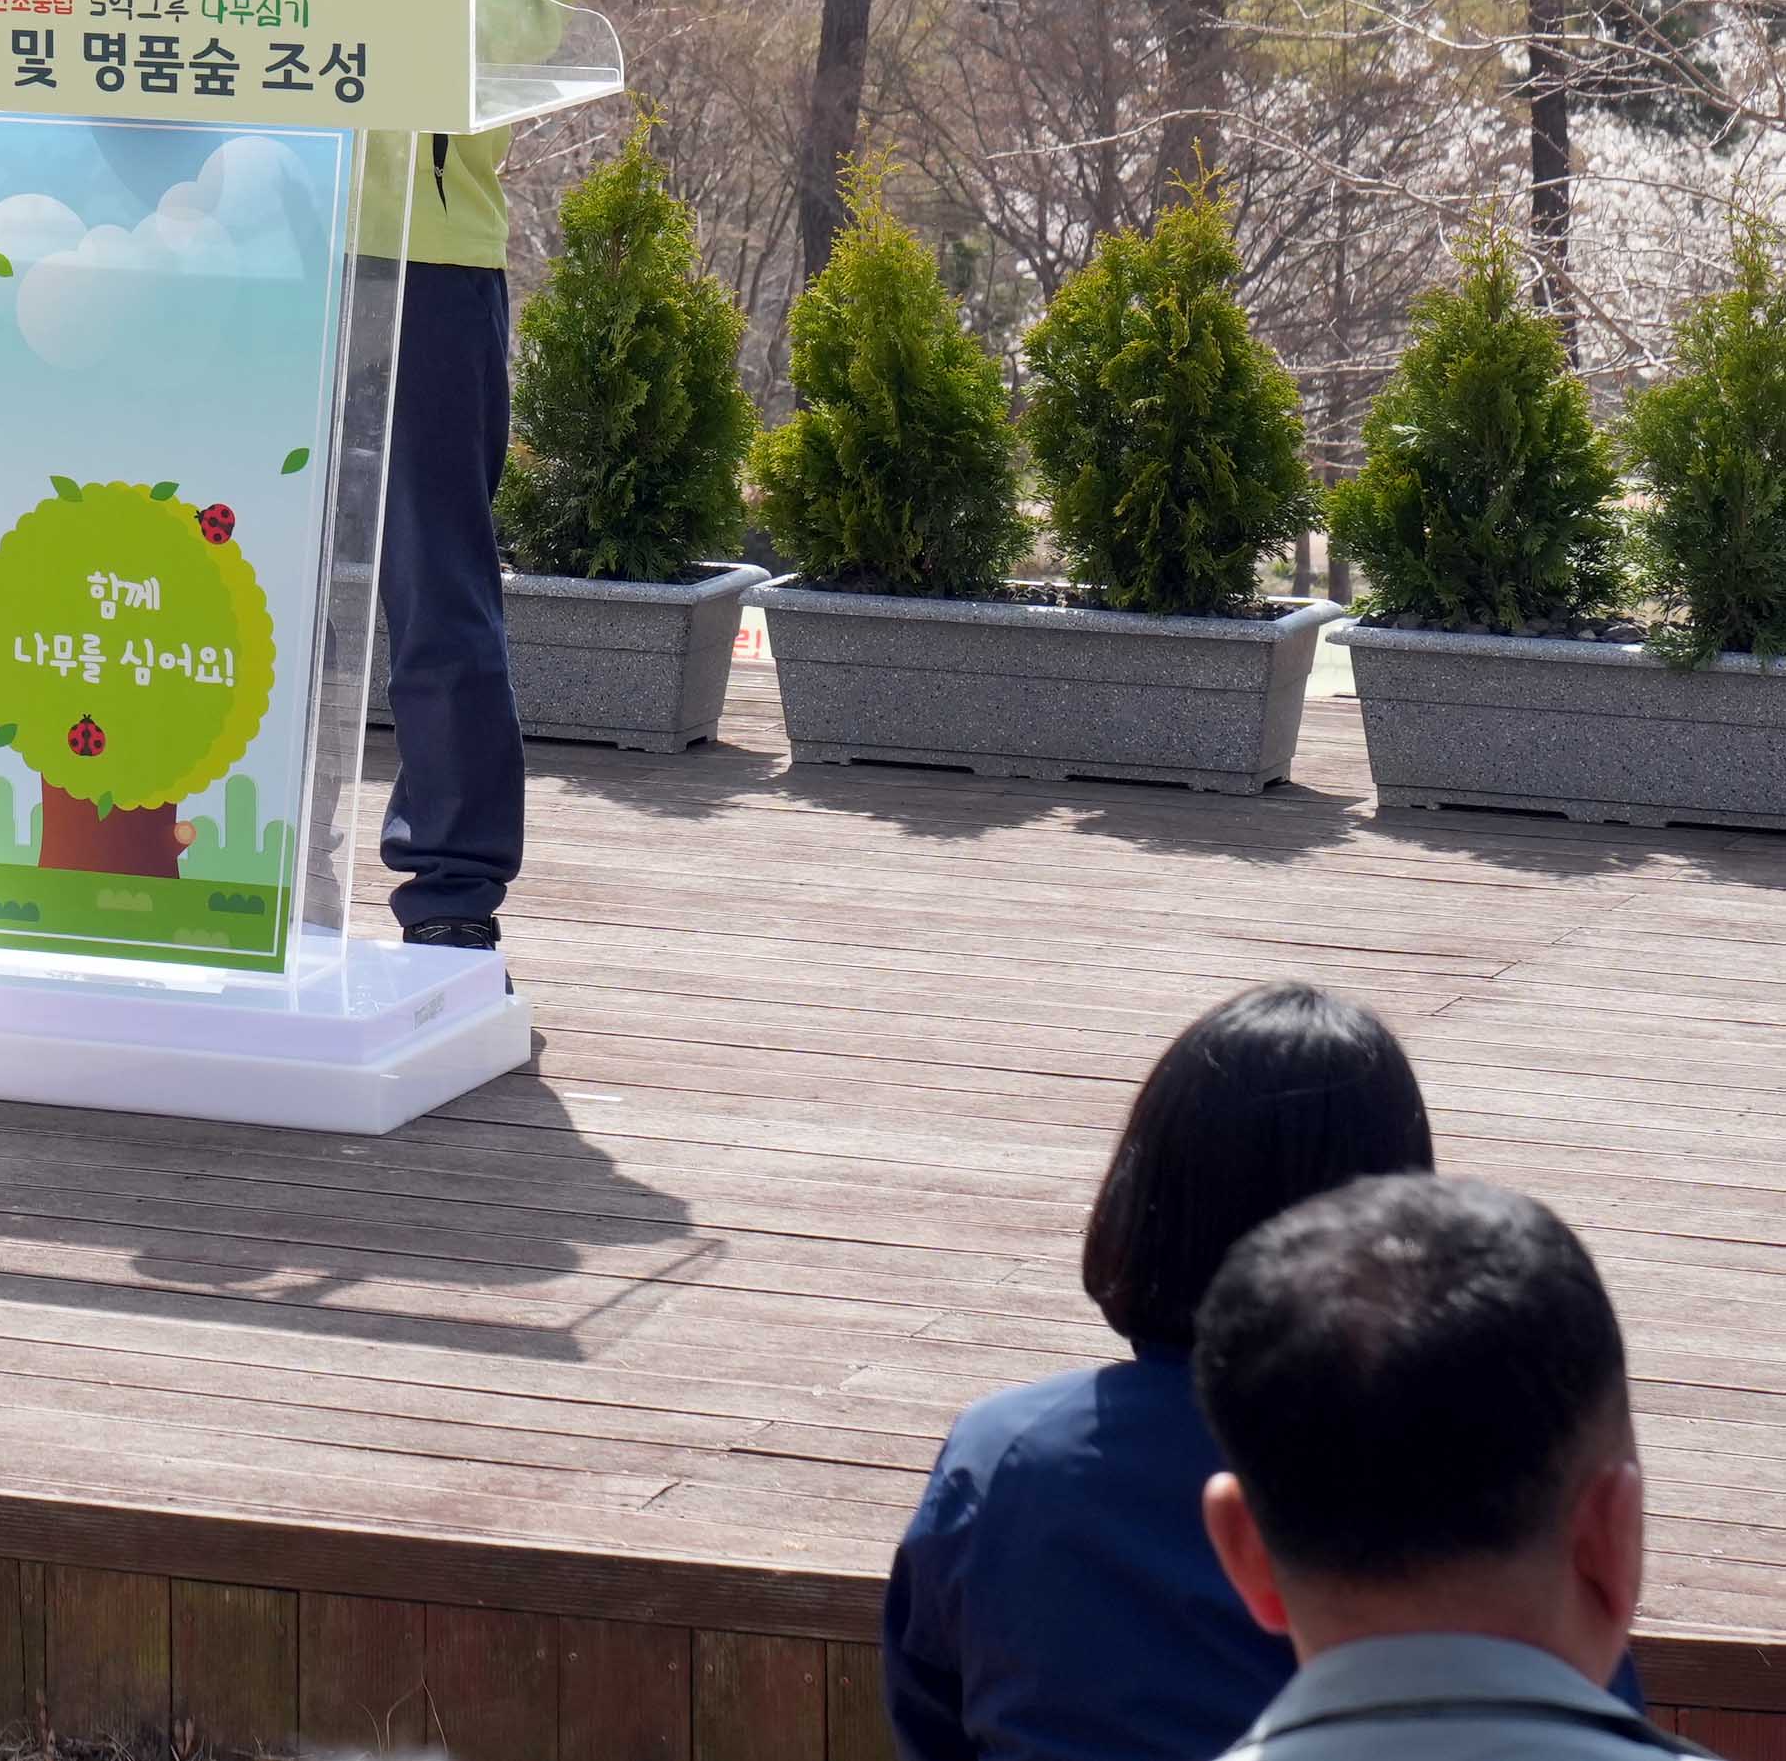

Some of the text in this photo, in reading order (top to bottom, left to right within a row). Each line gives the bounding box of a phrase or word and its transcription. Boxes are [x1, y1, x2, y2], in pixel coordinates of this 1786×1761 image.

[11, 29, 57, 89] 및
[83, 32, 241, 98] 명품숲
[262, 42, 367, 105] 조성
[87, 571, 161, 621] 함께
[14, 633, 235, 687] 나무를 심어요!
